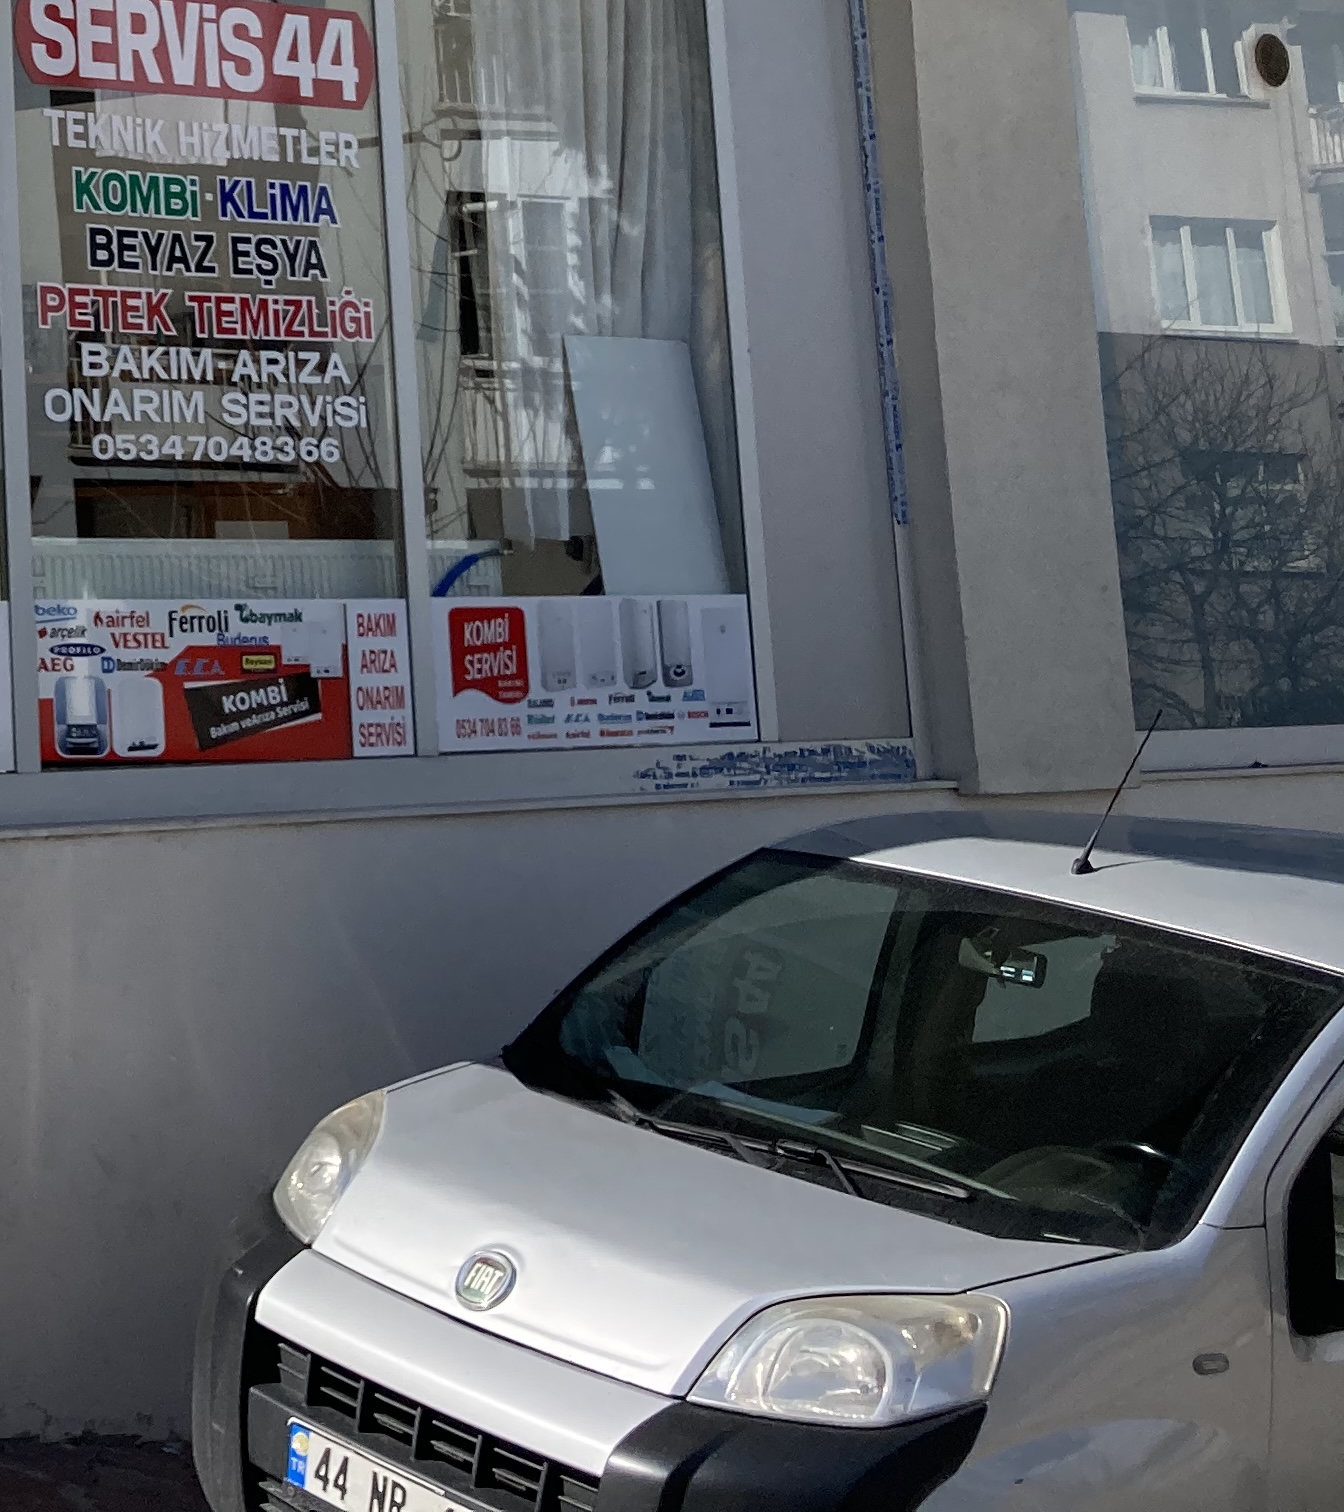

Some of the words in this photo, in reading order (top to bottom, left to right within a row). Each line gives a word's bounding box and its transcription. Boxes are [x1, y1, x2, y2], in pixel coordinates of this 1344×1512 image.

[272, 12, 360, 103] 44
[85, 223, 218, 277] BEYAZ
[229, 231, 331, 290] EŞYA
[36, 281, 177, 338] PETEK
[43, 387, 206, 425] ONARIM
[34, 603, 78, 617] beko
[105, 608, 151, 628] airfel
[167, 609, 230, 638] Ferroli
[356, 612, 398, 638] BAKIM
[463, 612, 511, 648] KOMBİ
[110, 631, 170, 650] VESTEL
[37, 656, 75, 673] AEG
[360, 648, 399, 675] ARIZA
[221, 676, 290, 715] KOMBİ
[356, 685, 406, 712] ONARIM
[464, 1262, 505, 1295] FIAT
[290, 1457, 307, 1474] TR
[314, 1447, 350, 1502] 44
